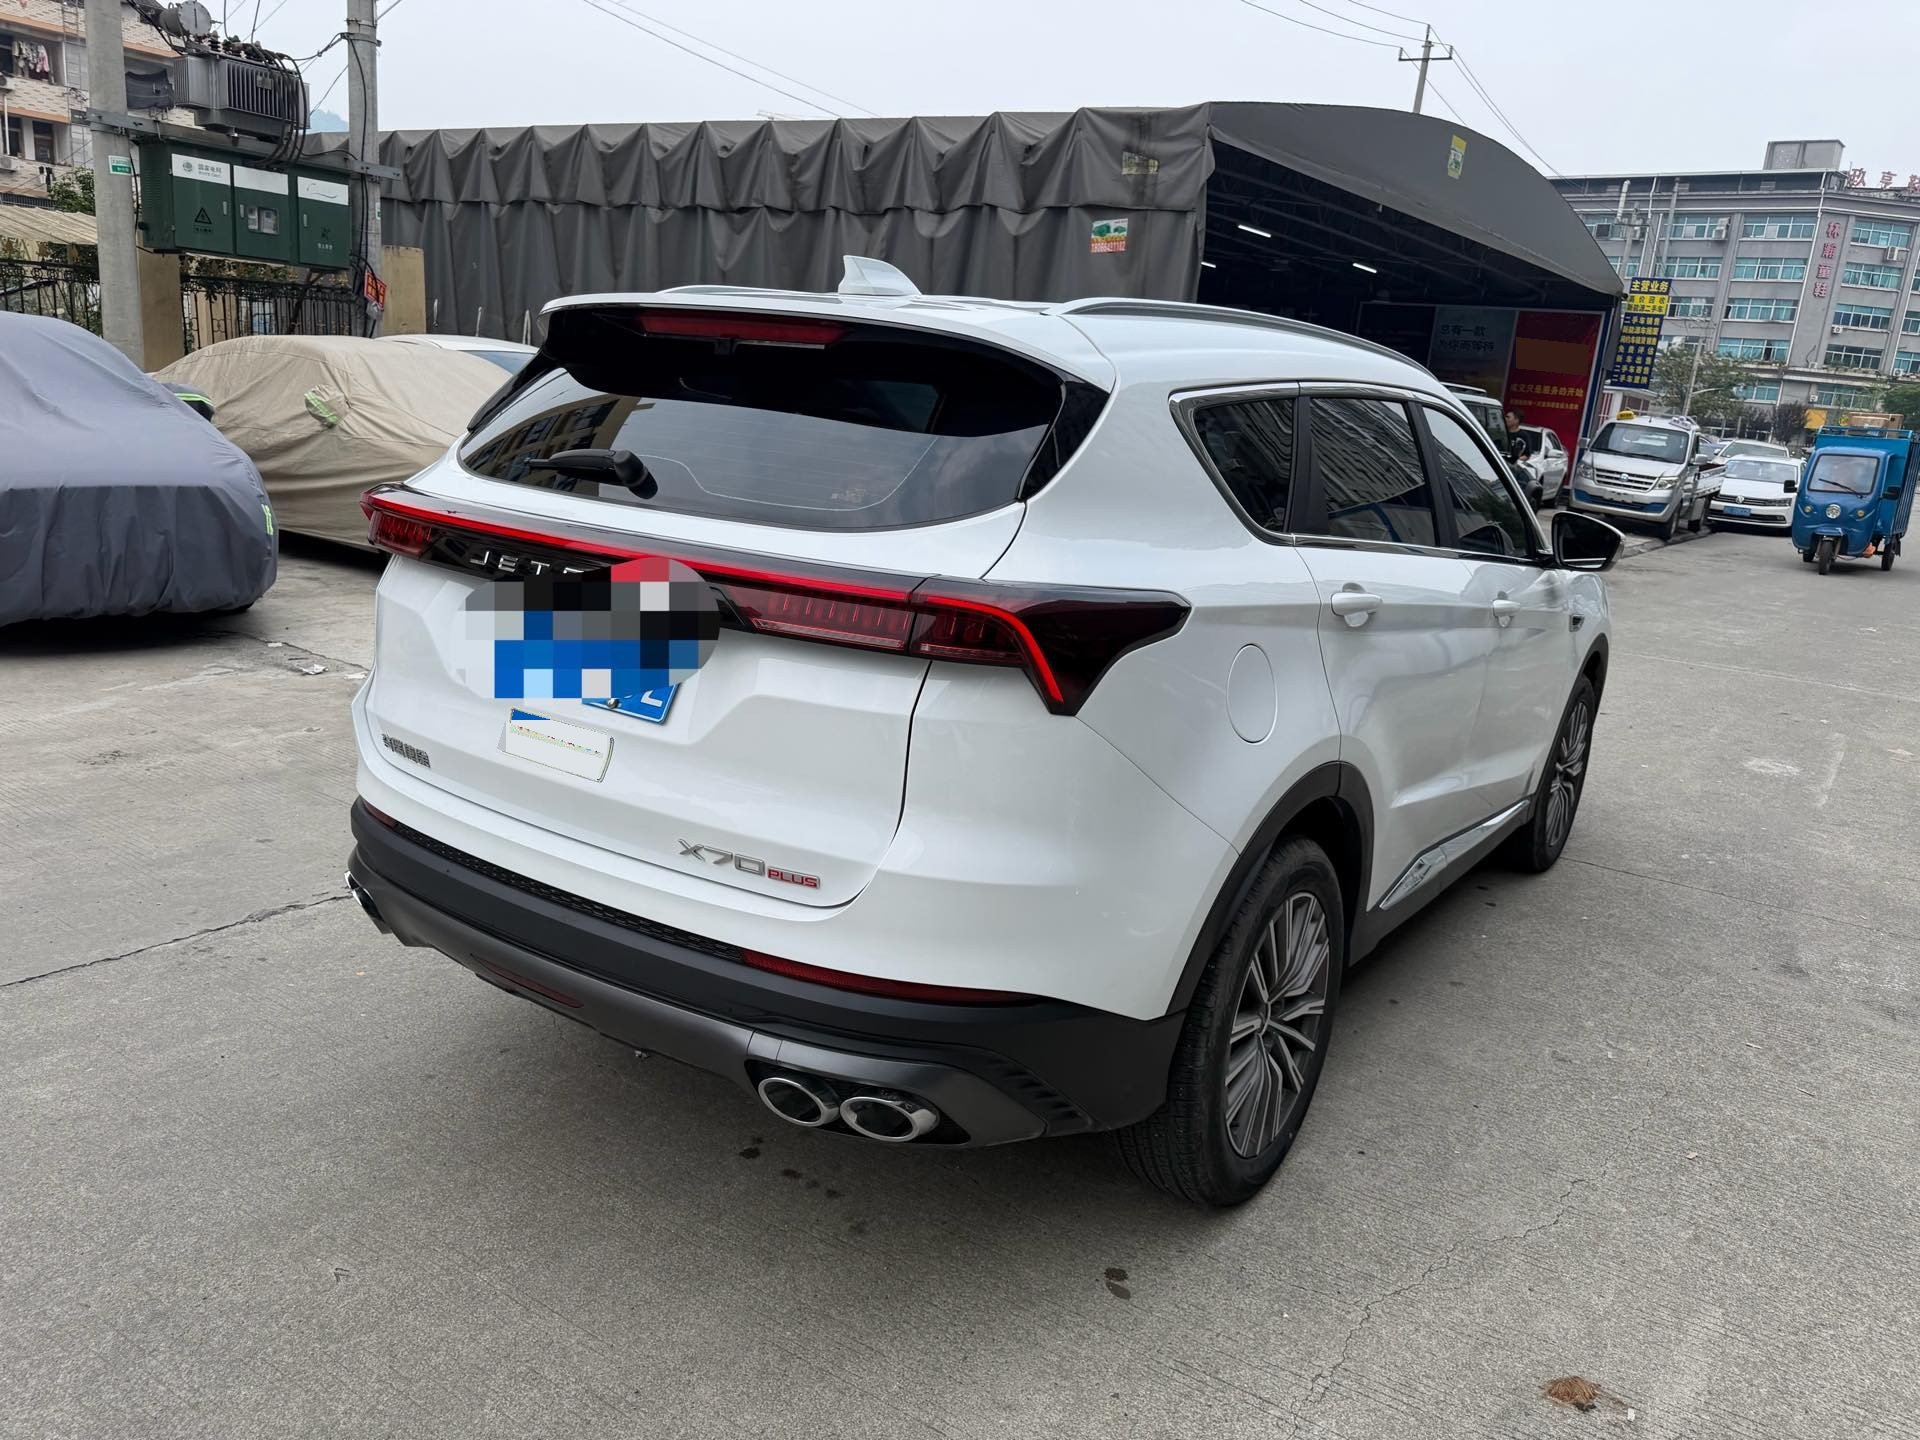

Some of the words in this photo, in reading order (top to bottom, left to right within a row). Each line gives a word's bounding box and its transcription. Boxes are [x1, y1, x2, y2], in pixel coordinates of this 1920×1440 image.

[1631, 279, 1669, 292] 主营业务
[1440, 324, 1487, 336] 总有一款
[1509, 384, 1584, 397] 成交只是服务的开始
[469, 550, 585, 576] JET
[677, 838, 767, 876] X70
[767, 867, 819, 890] PLUS
